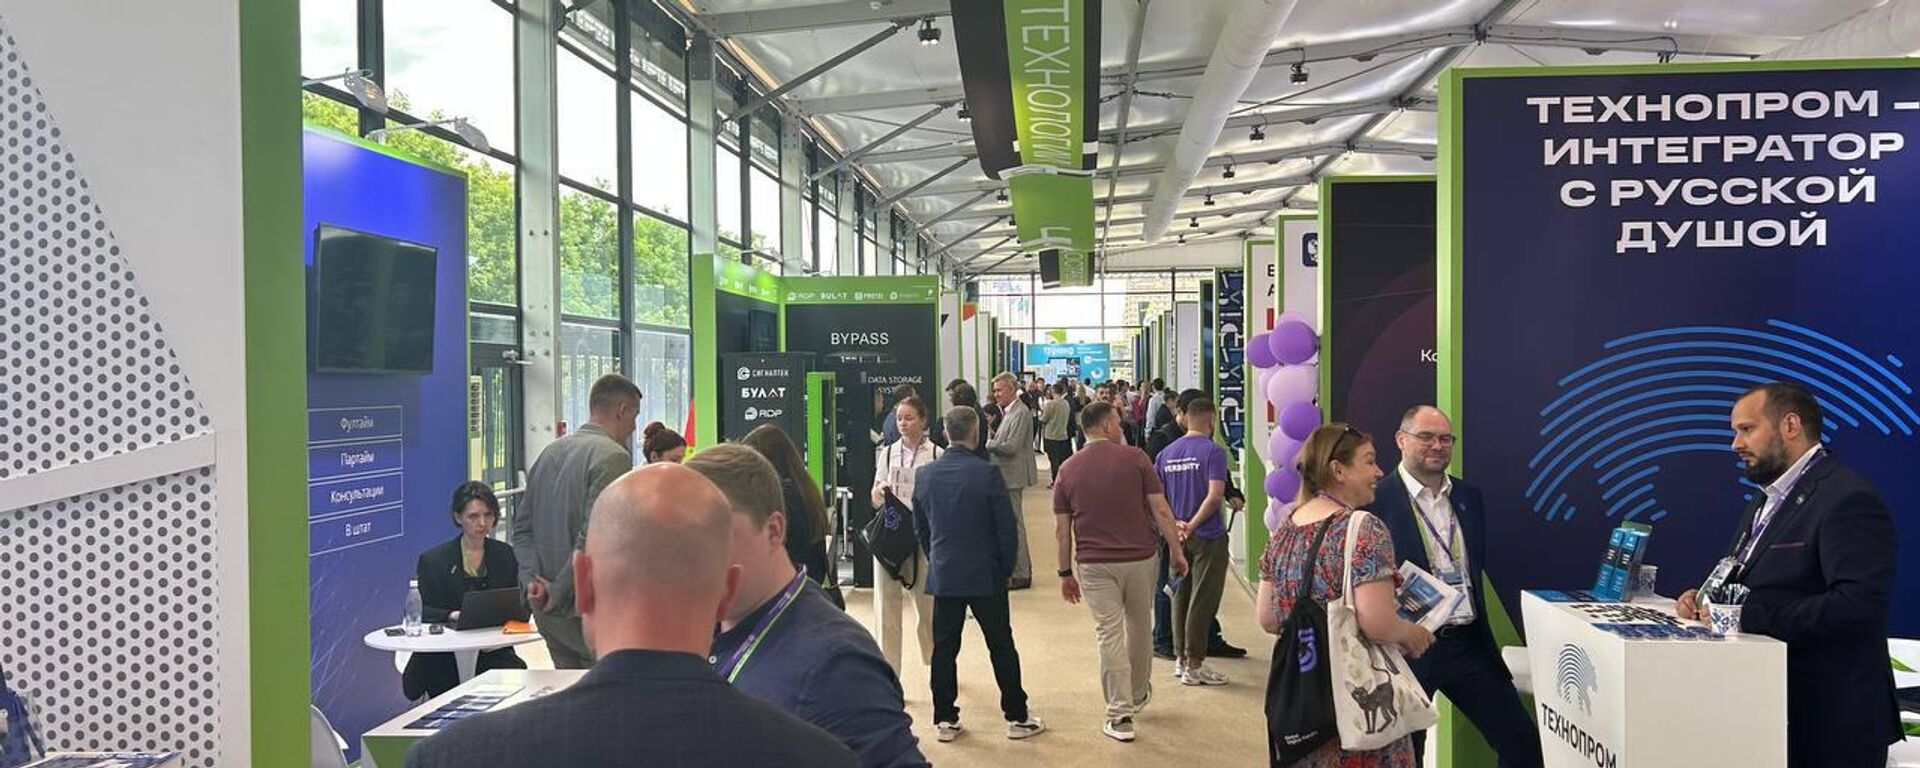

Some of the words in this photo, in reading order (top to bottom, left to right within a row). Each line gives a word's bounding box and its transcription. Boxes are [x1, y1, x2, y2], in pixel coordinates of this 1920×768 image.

[1526, 90, 1879, 124] ТЕХНОПРОМ
[1543, 132, 1905, 166] ИНТЕГРАТОР
[1559, 179, 1596, 207] С
[1610, 168, 1876, 207] РУССКОЙ
[1616, 211, 1827, 254] ДУШОЙ
[830, 332, 890, 345] BYPASS
[867, 375, 887, 384] DATA
[888, 375, 923, 384] STORAGE
[340, 450, 375, 468] Партайм
[330, 486, 384, 504] Консультации
[345, 523, 352, 537] В
[352, 521, 372, 537] штат
[1541, 702, 1617, 768] ТЕХНОПРОМ
